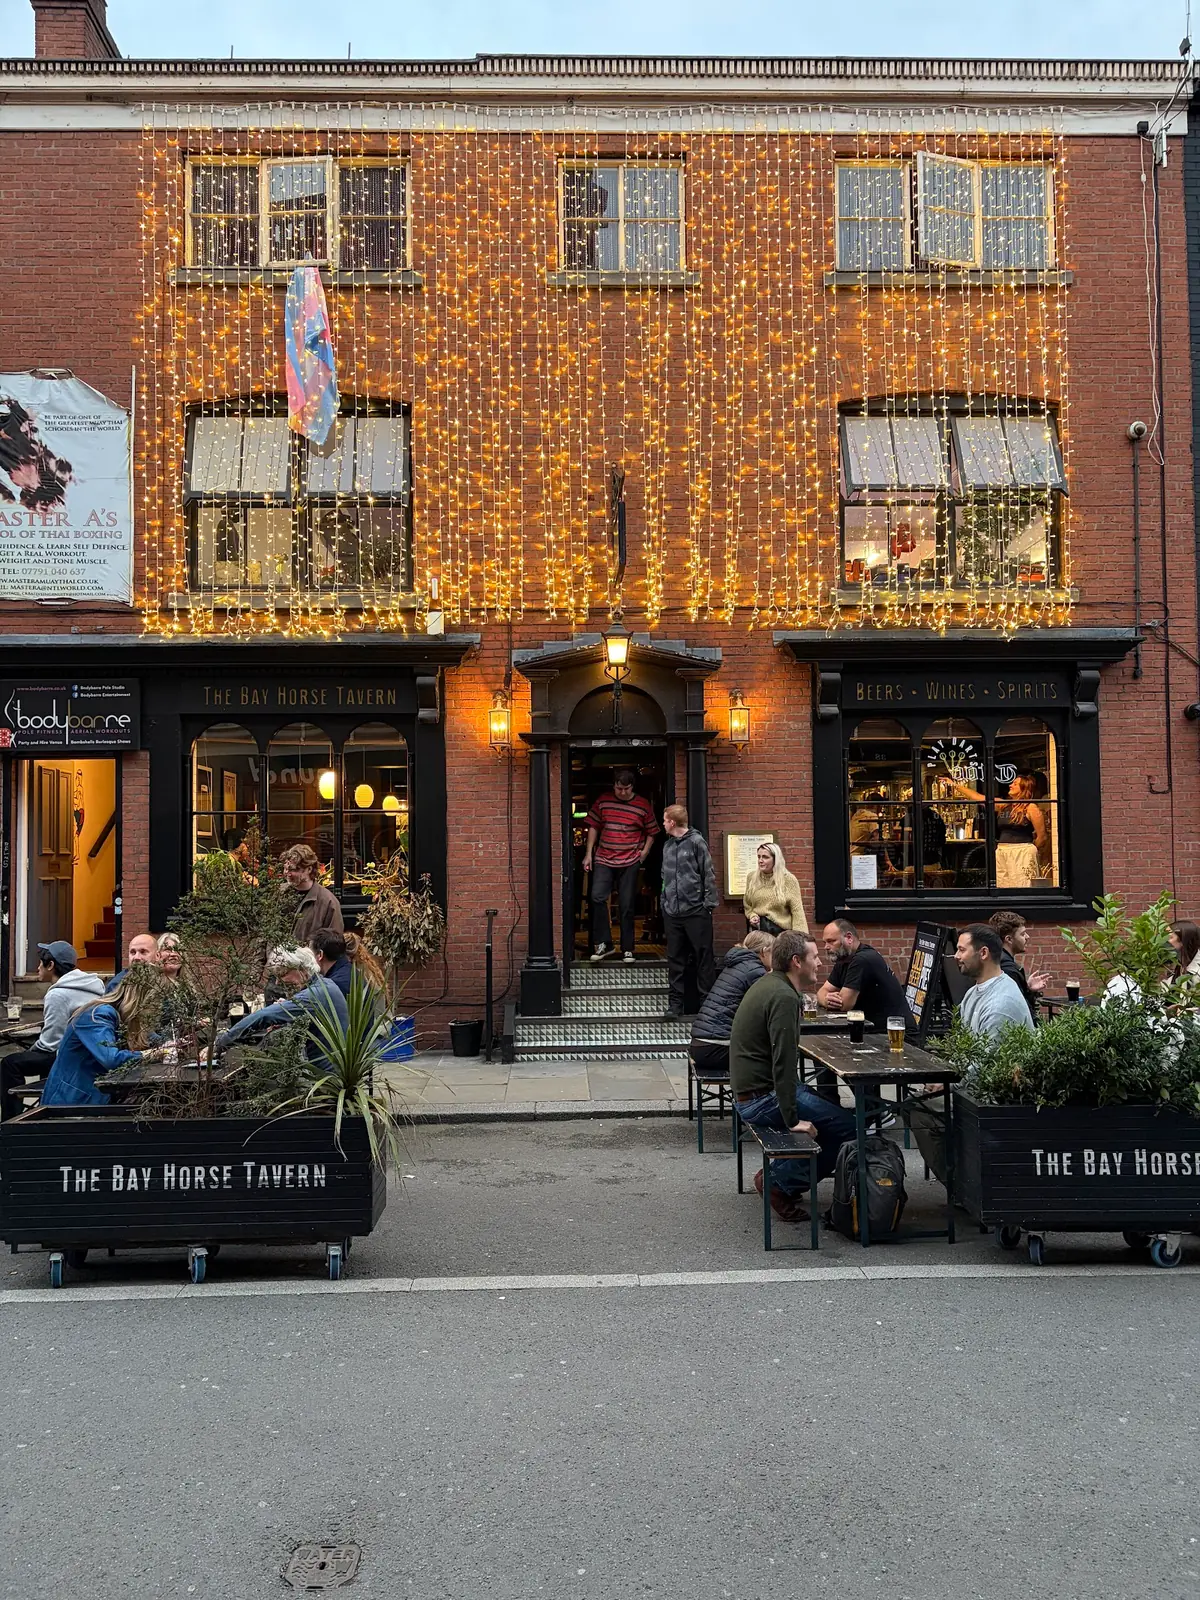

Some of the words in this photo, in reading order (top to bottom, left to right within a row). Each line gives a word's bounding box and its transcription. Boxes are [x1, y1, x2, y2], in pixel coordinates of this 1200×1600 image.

[19, 530, 36, 539] OF
[39, 530, 70, 539] THAI
[73, 530, 123, 540] BOXING
[21, 568, 48, 576] 07791
[51, 568, 68, 576] 040
[203, 686, 232, 705] THE
[240, 686, 269, 705] BAY
[278, 686, 328, 705] HORSE
[336, 686, 396, 705] TAVERN
[856, 682, 903, 701] BEERS
[926, 681, 976, 700] WINES
[997, 680, 1057, 699] SPIRITS
[926, 739, 945, 768] PLAY
[1031, 1148, 1073, 1176] THE
[1083, 1148, 1123, 1176] BAY
[59, 1165, 100, 1193] THE
[112, 1164, 152, 1192] BAY
[163, 1163, 233, 1190] HORSE
[243, 1161, 327, 1189] TAVERN
[297, 1548, 356, 1560] WATER
